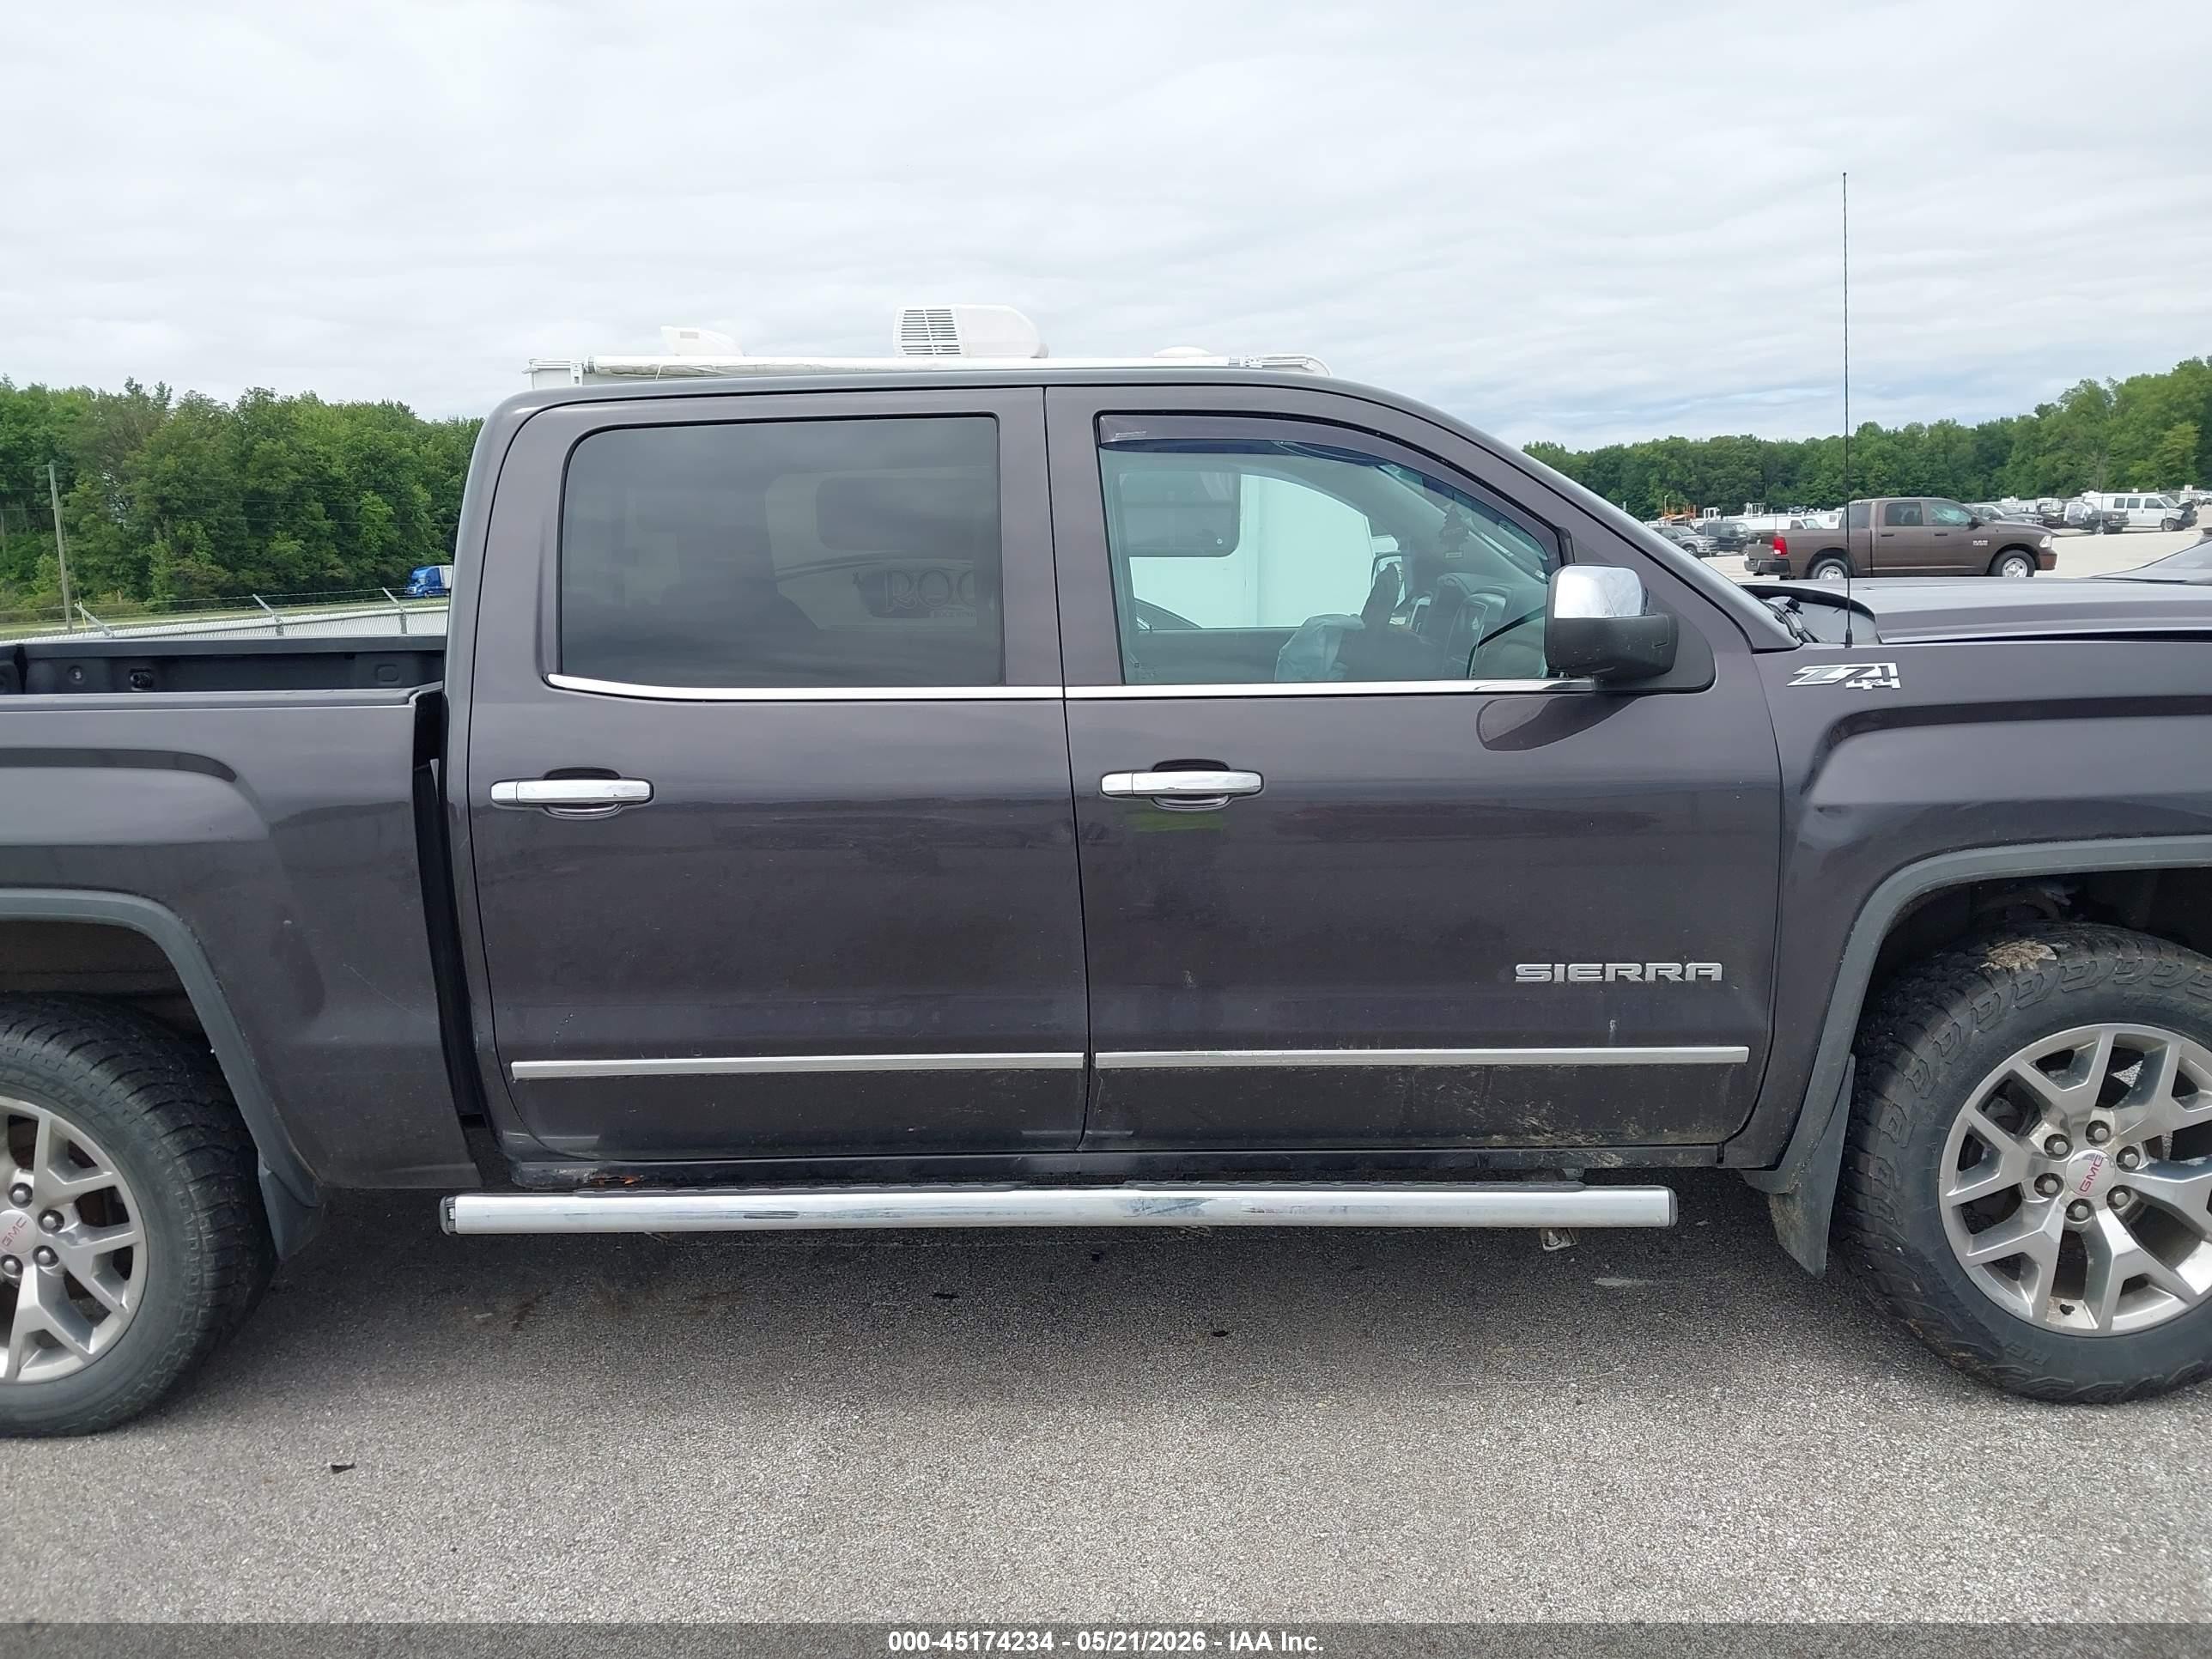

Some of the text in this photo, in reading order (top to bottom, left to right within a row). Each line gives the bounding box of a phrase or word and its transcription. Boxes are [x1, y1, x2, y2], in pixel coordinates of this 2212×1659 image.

[1787, 662, 1899, 686] Z71
[1515, 963, 1723, 982] SIERRA
[2079, 1154, 2104, 1193] GMC
[2, 1217, 27, 1247] GMC
